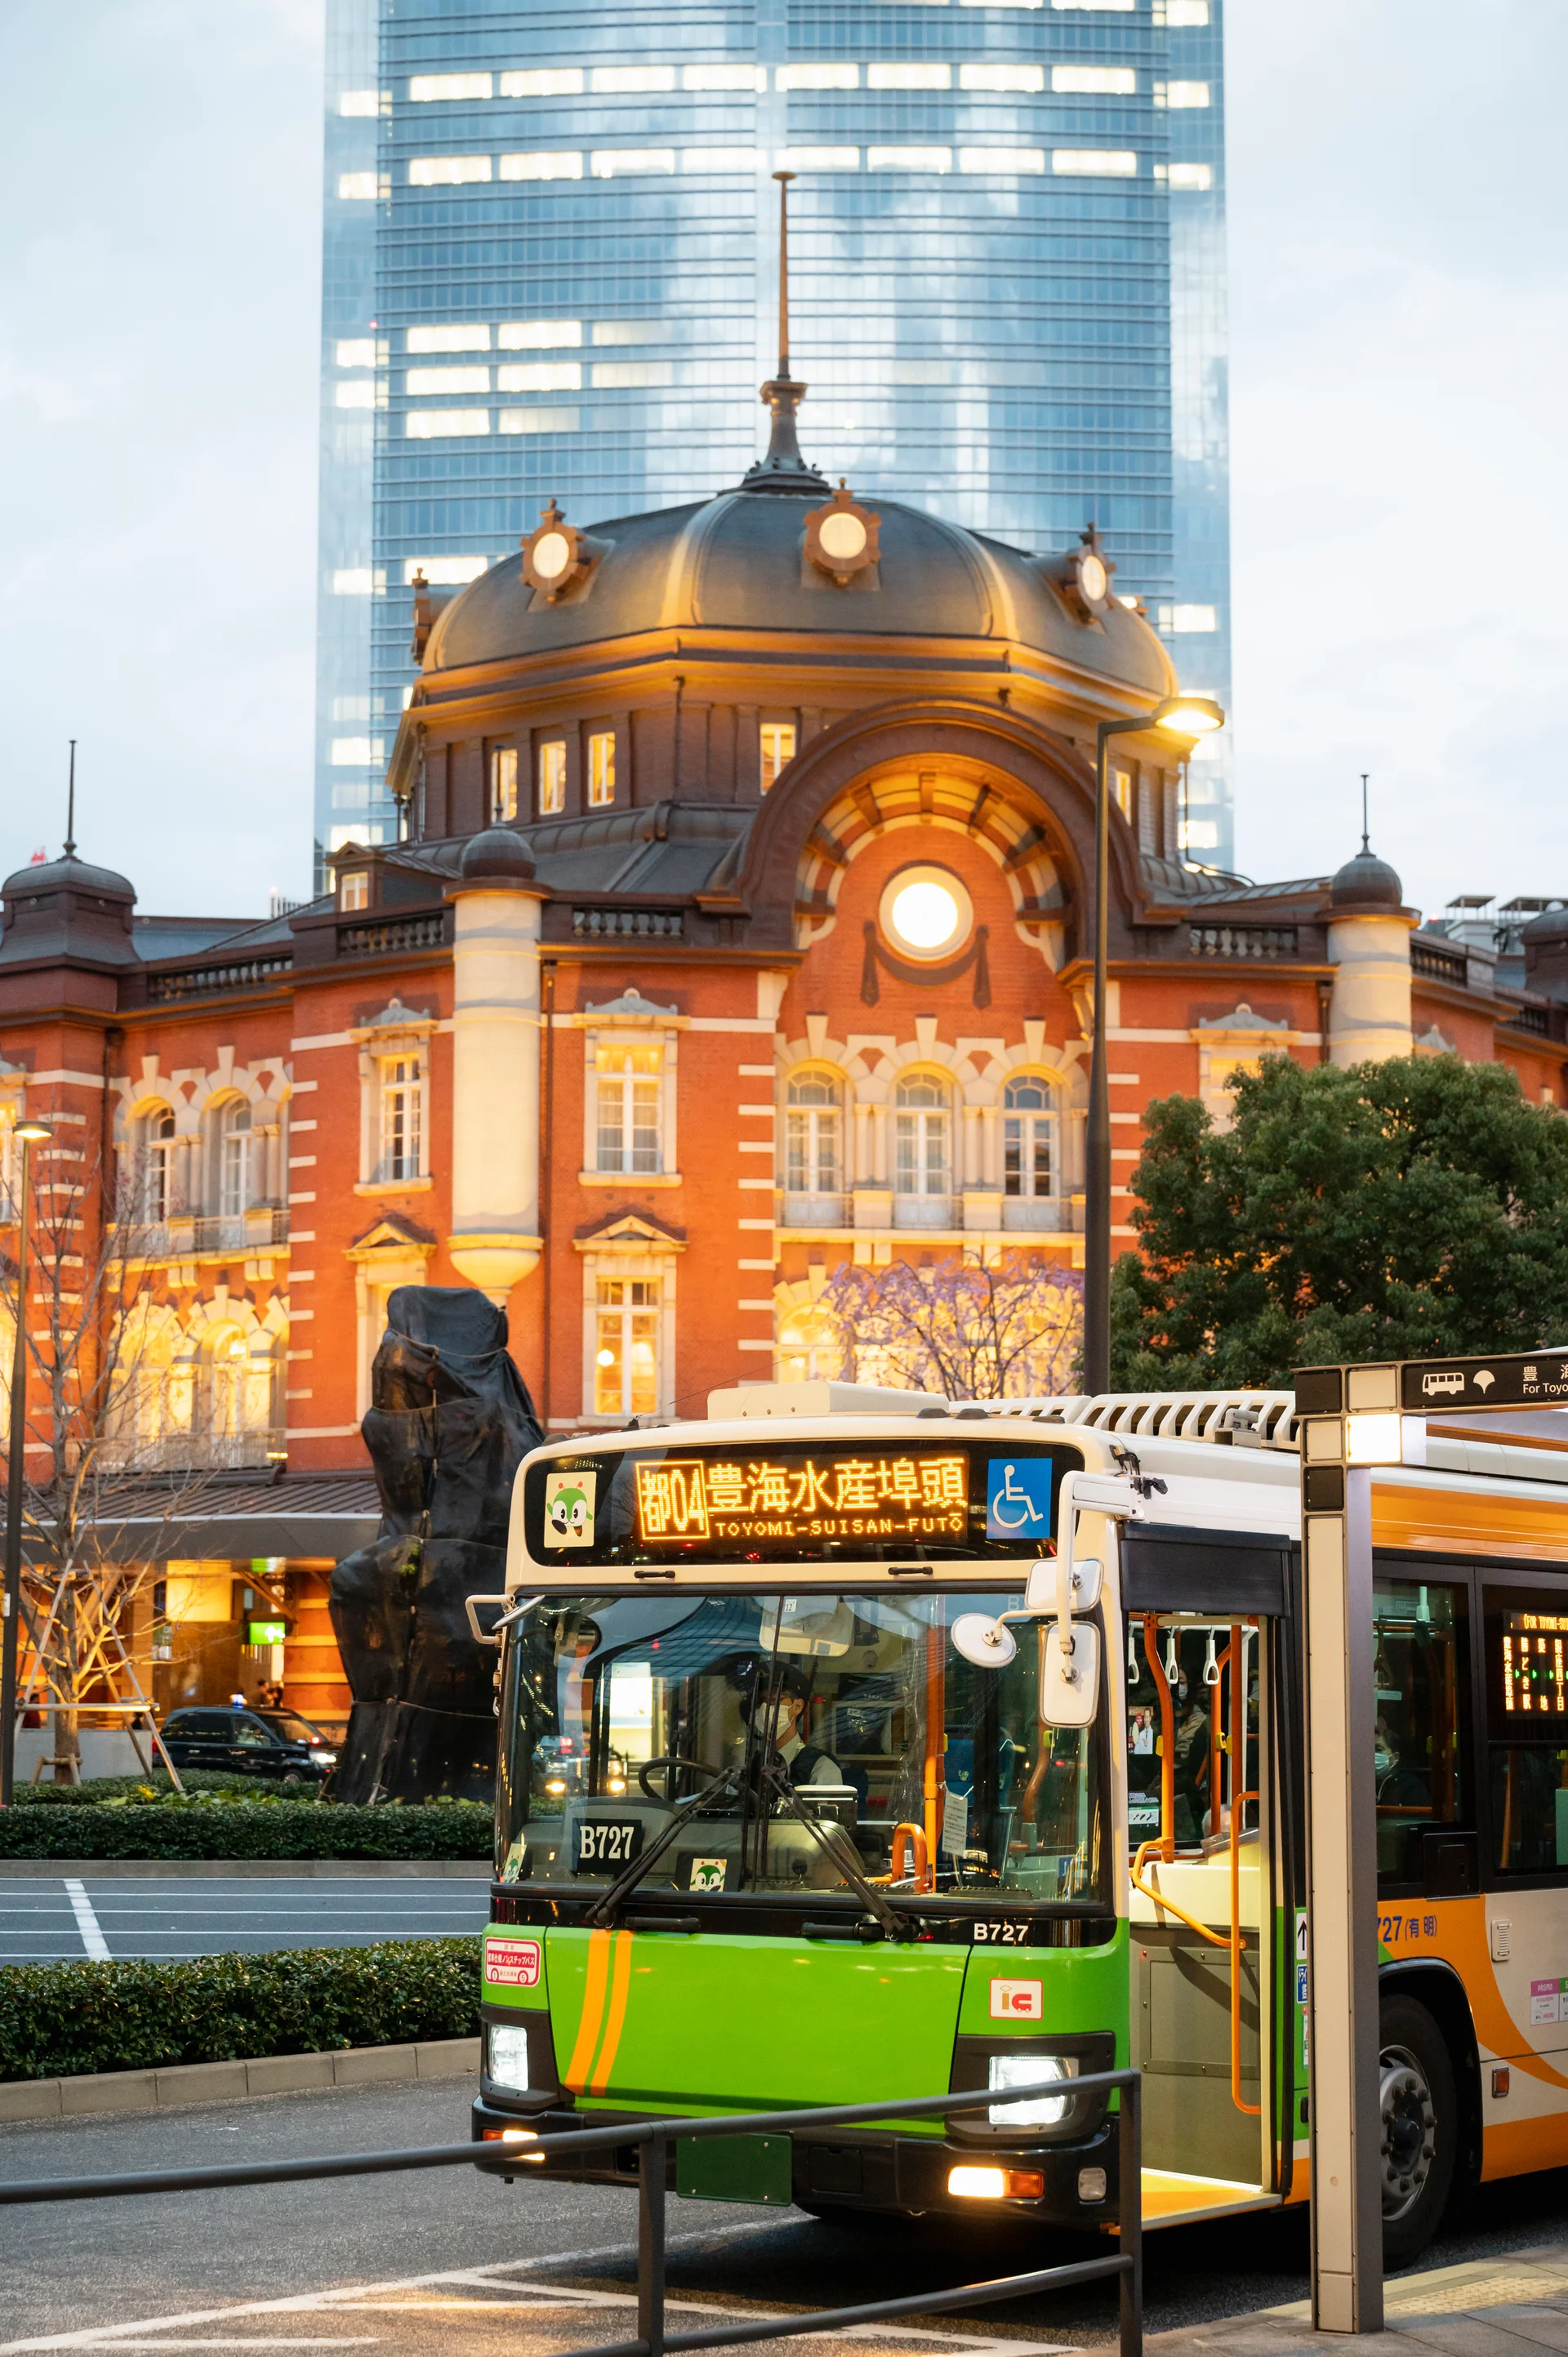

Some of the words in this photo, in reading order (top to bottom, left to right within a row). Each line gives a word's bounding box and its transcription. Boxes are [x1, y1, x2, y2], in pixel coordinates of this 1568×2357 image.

[1522, 1383, 1540, 1394] For
[706, 1458, 968, 1513] 豊海水産埠頭
[579, 1825, 635, 1860] B727
[973, 1923, 1029, 1942] B727
